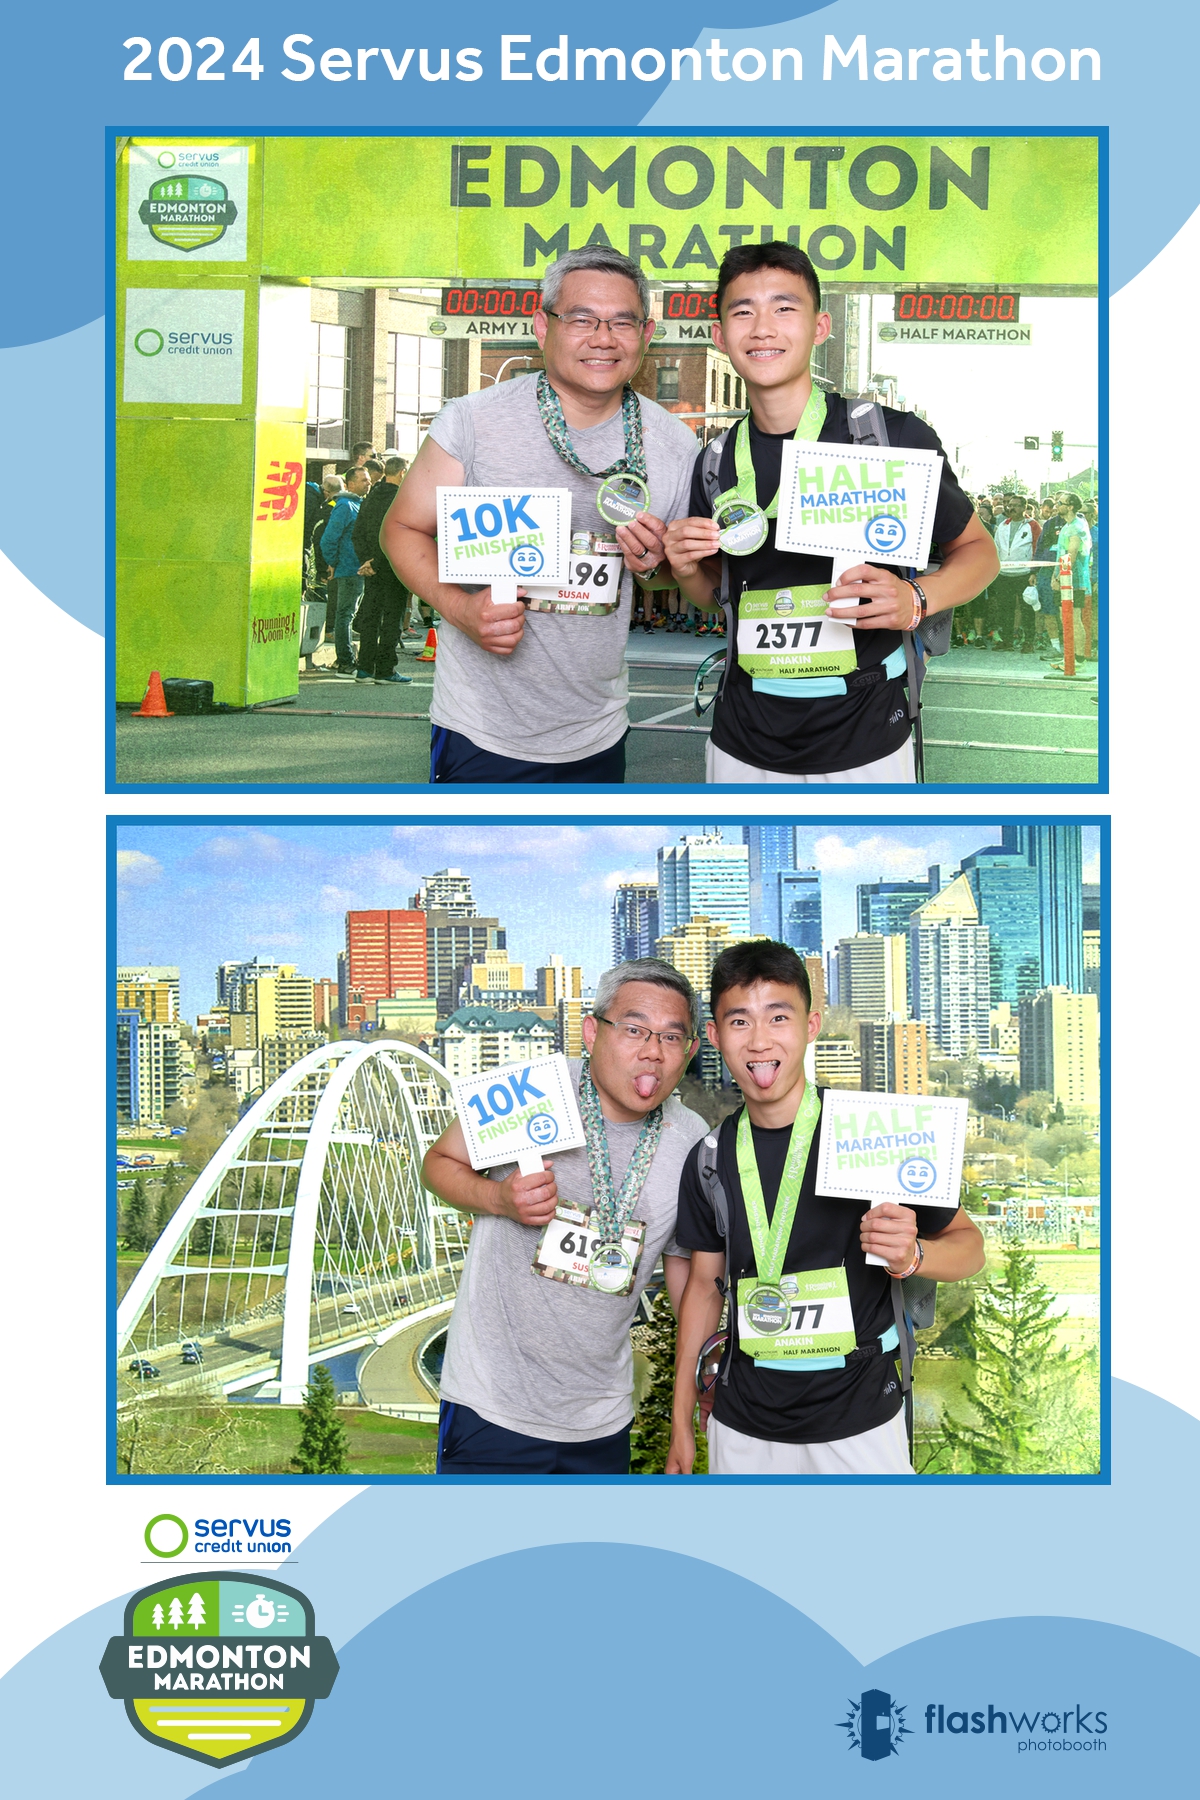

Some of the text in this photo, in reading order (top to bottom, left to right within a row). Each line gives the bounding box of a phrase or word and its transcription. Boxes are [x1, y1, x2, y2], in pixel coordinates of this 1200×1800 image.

[178, 152, 220, 161] servus
[450, 144, 990, 211] EDMONTON
[149, 203, 227, 214] EDMONTON
[160, 214, 215, 222] MARATHON
[168, 332, 233, 345] servus
[466, 321, 518, 335] ARMY
[901, 328, 1030, 341] HALF MARATHON
[168, 345, 233, 355] credit union
[798, 460, 905, 494] HALF
[800, 488, 906, 508] MARATHON
[450, 494, 540, 542] 10K
[801, 503, 908, 526] FINISHER!
[454, 532, 545, 560] FINISHER!
[568, 561, 609, 587] 96
[558, 590, 590, 600] SUSAN
[555, 603, 576, 611] ARMY
[257, 613, 290, 637] Running
[756, 621, 823, 649] 2377
[769, 655, 812, 665] ANAKIN
[798, 665, 840, 673] MARATHON
[467, 1065, 546, 1127] 10K
[477, 1099, 555, 1144] FINISHER!
[833, 1104, 933, 1140] HALF
[836, 1131, 935, 1153] MARATHON
[837, 1145, 938, 1170] FINISHER!
[771, 1227, 783, 1261] MARATHON
[572, 1261, 589, 1273] SUS
[785, 1304, 825, 1331] 77
[774, 1337, 814, 1347] ANAKIN
[800, 1346, 840, 1355] MARATHON
